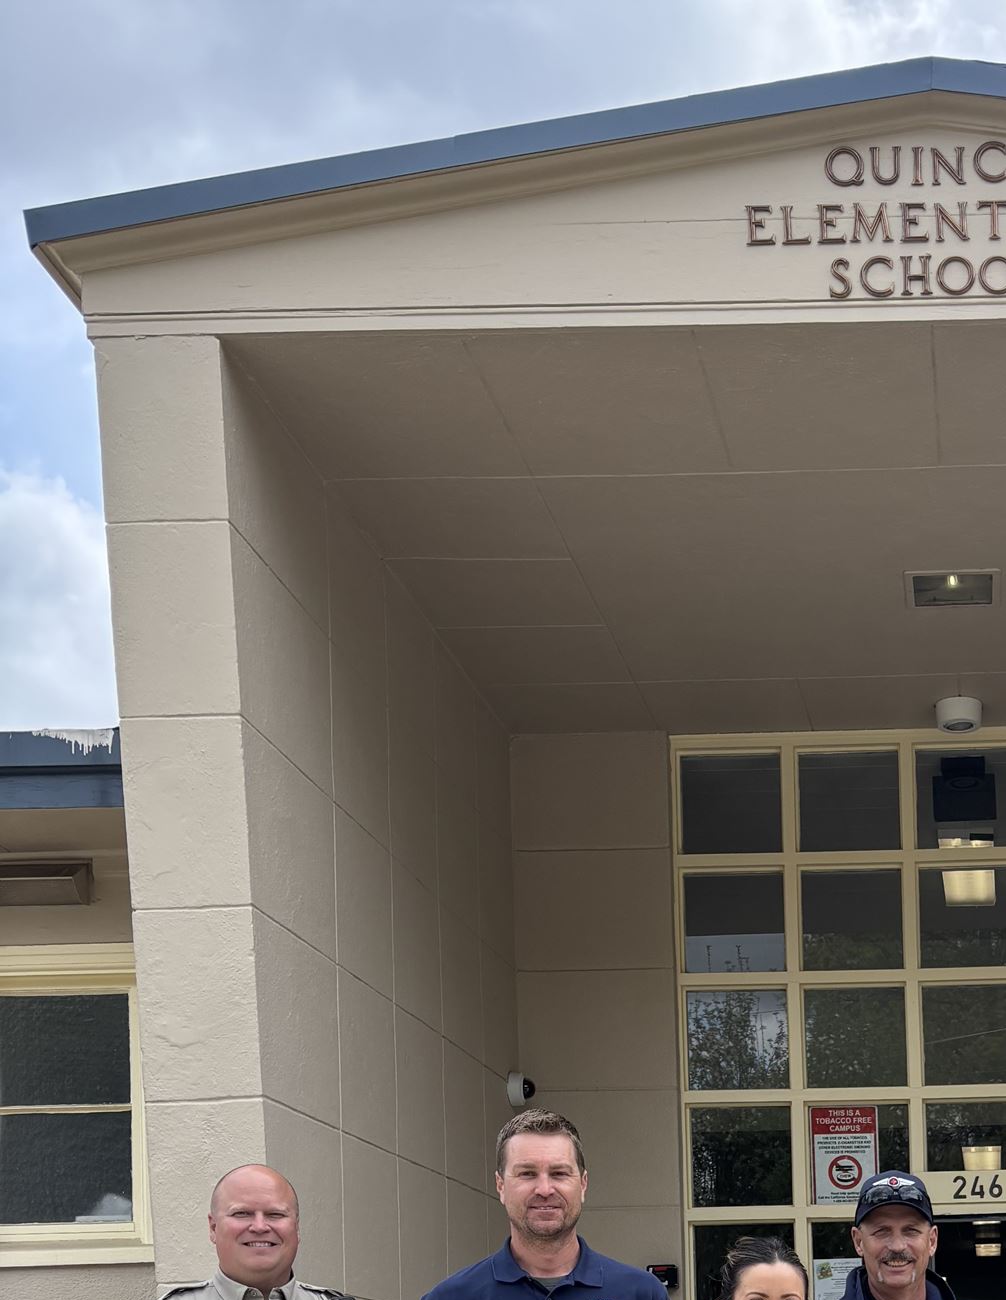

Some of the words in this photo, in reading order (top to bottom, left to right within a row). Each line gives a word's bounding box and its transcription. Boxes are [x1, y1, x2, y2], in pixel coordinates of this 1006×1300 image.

[828, 1109, 845, 1117] THIS
[846, 1109, 854, 1117] IS
[854, 1109, 861, 1117] A
[815, 1117, 852, 1125] TOBACCO
[852, 1116, 873, 1124] FREE
[952, 1174, 1003, 1200] 246
